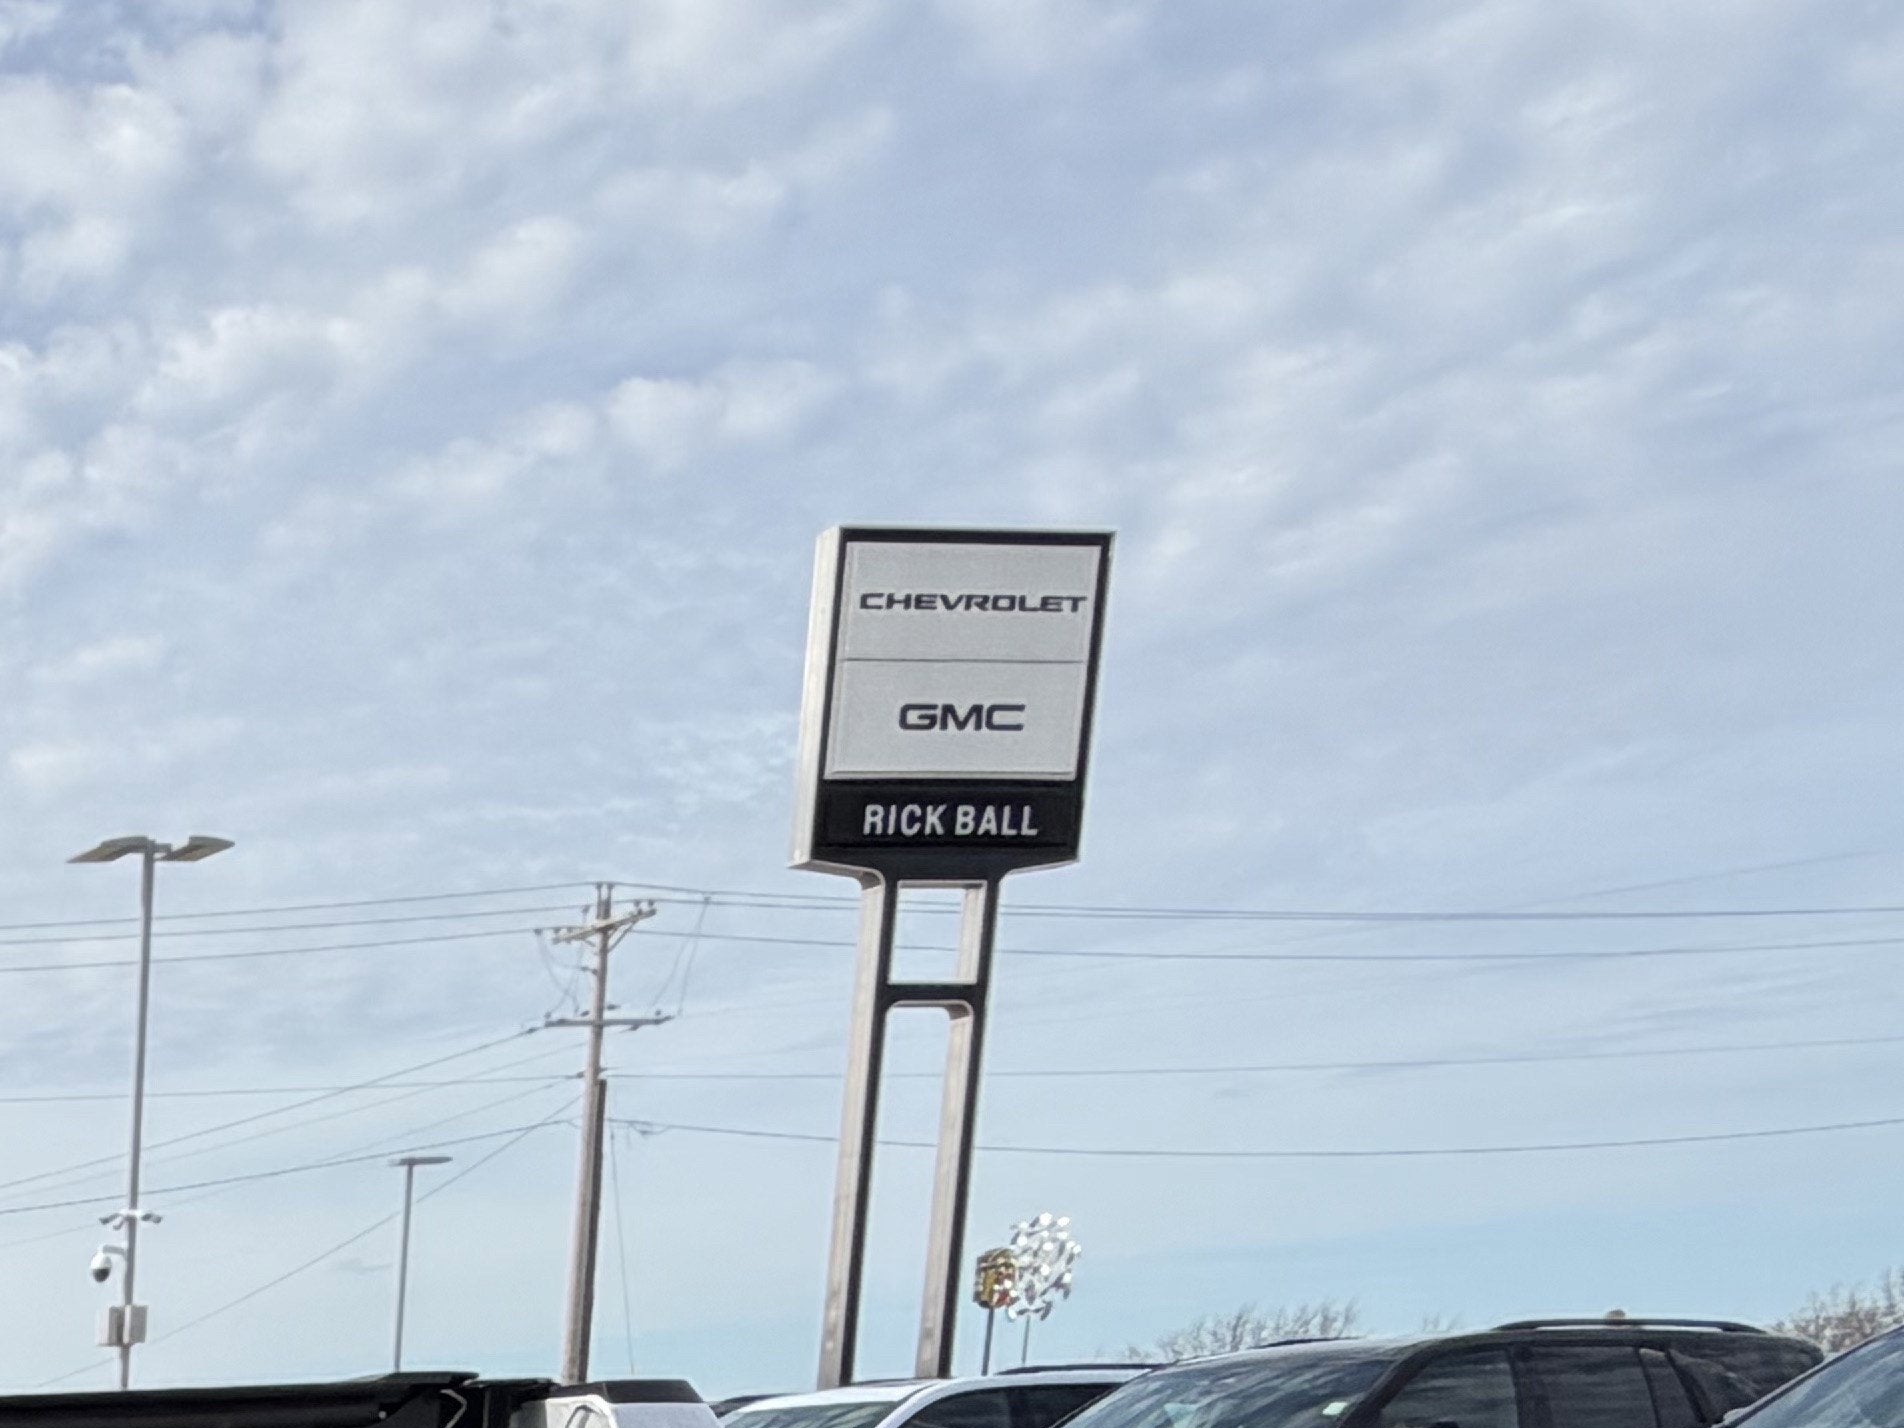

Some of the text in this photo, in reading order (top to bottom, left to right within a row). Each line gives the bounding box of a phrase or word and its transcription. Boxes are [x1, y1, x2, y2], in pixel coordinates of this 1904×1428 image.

[859, 592, 1089, 614] CHEVROLET
[898, 703, 1026, 732] GMC
[862, 803, 1039, 837] RICK BALL
